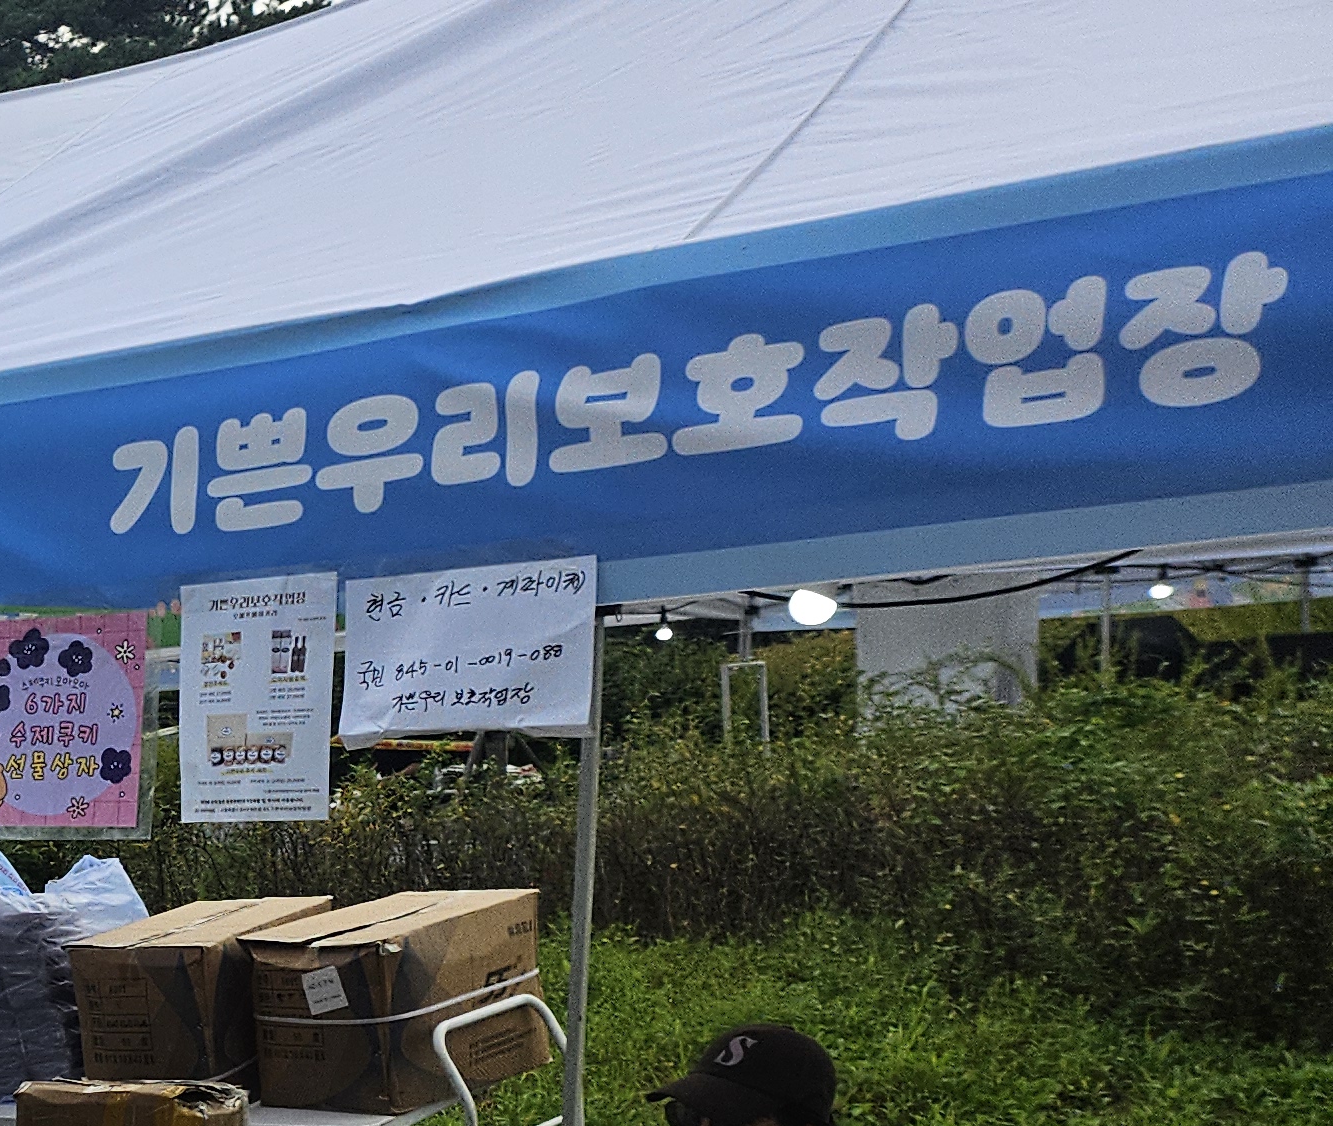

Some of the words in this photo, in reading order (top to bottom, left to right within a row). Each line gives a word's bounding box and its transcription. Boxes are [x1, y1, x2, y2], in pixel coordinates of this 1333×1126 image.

[110, 251, 1288, 534] 기쁜우리보호작업장
[366, 592, 406, 622] 현금
[25, 692, 87, 715] 6가지
[10, 720, 99, 748] 수제쿠키
[4, 750, 100, 781] 선물상자
